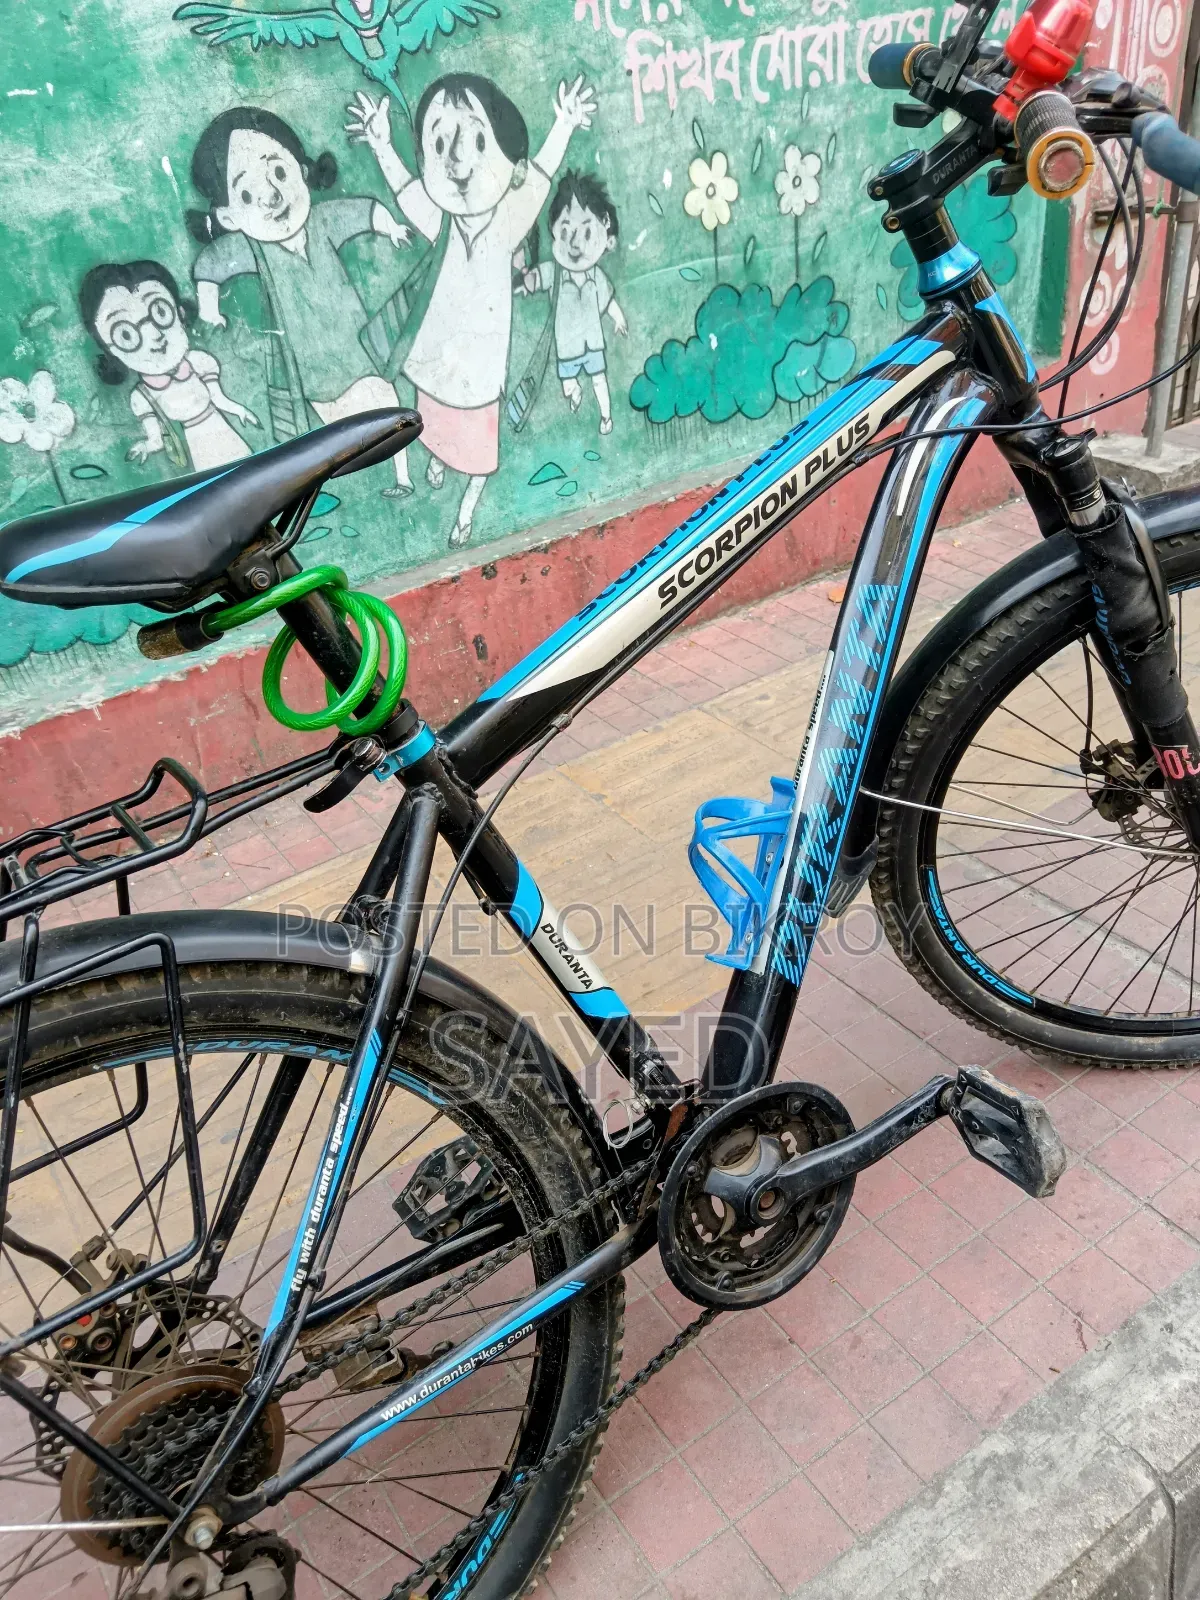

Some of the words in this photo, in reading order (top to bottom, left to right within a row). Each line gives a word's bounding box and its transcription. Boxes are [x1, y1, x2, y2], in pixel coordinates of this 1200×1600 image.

[624, 29, 745, 123] শিখব
[751, 16, 850, 103] মোরা
[658, 474, 798, 610] SCORPION
[805, 412, 870, 487] PLUS
[540, 922, 594, 990] DURANTA
[934, 907, 999, 985] DURANTA
[193, 1040, 350, 1062] DURAN
[291, 1267, 307, 1292] fly
[300, 1227, 317, 1266] with
[310, 1157, 335, 1224] duranta
[380, 1322, 533, 1421] www.durantabikes.com
